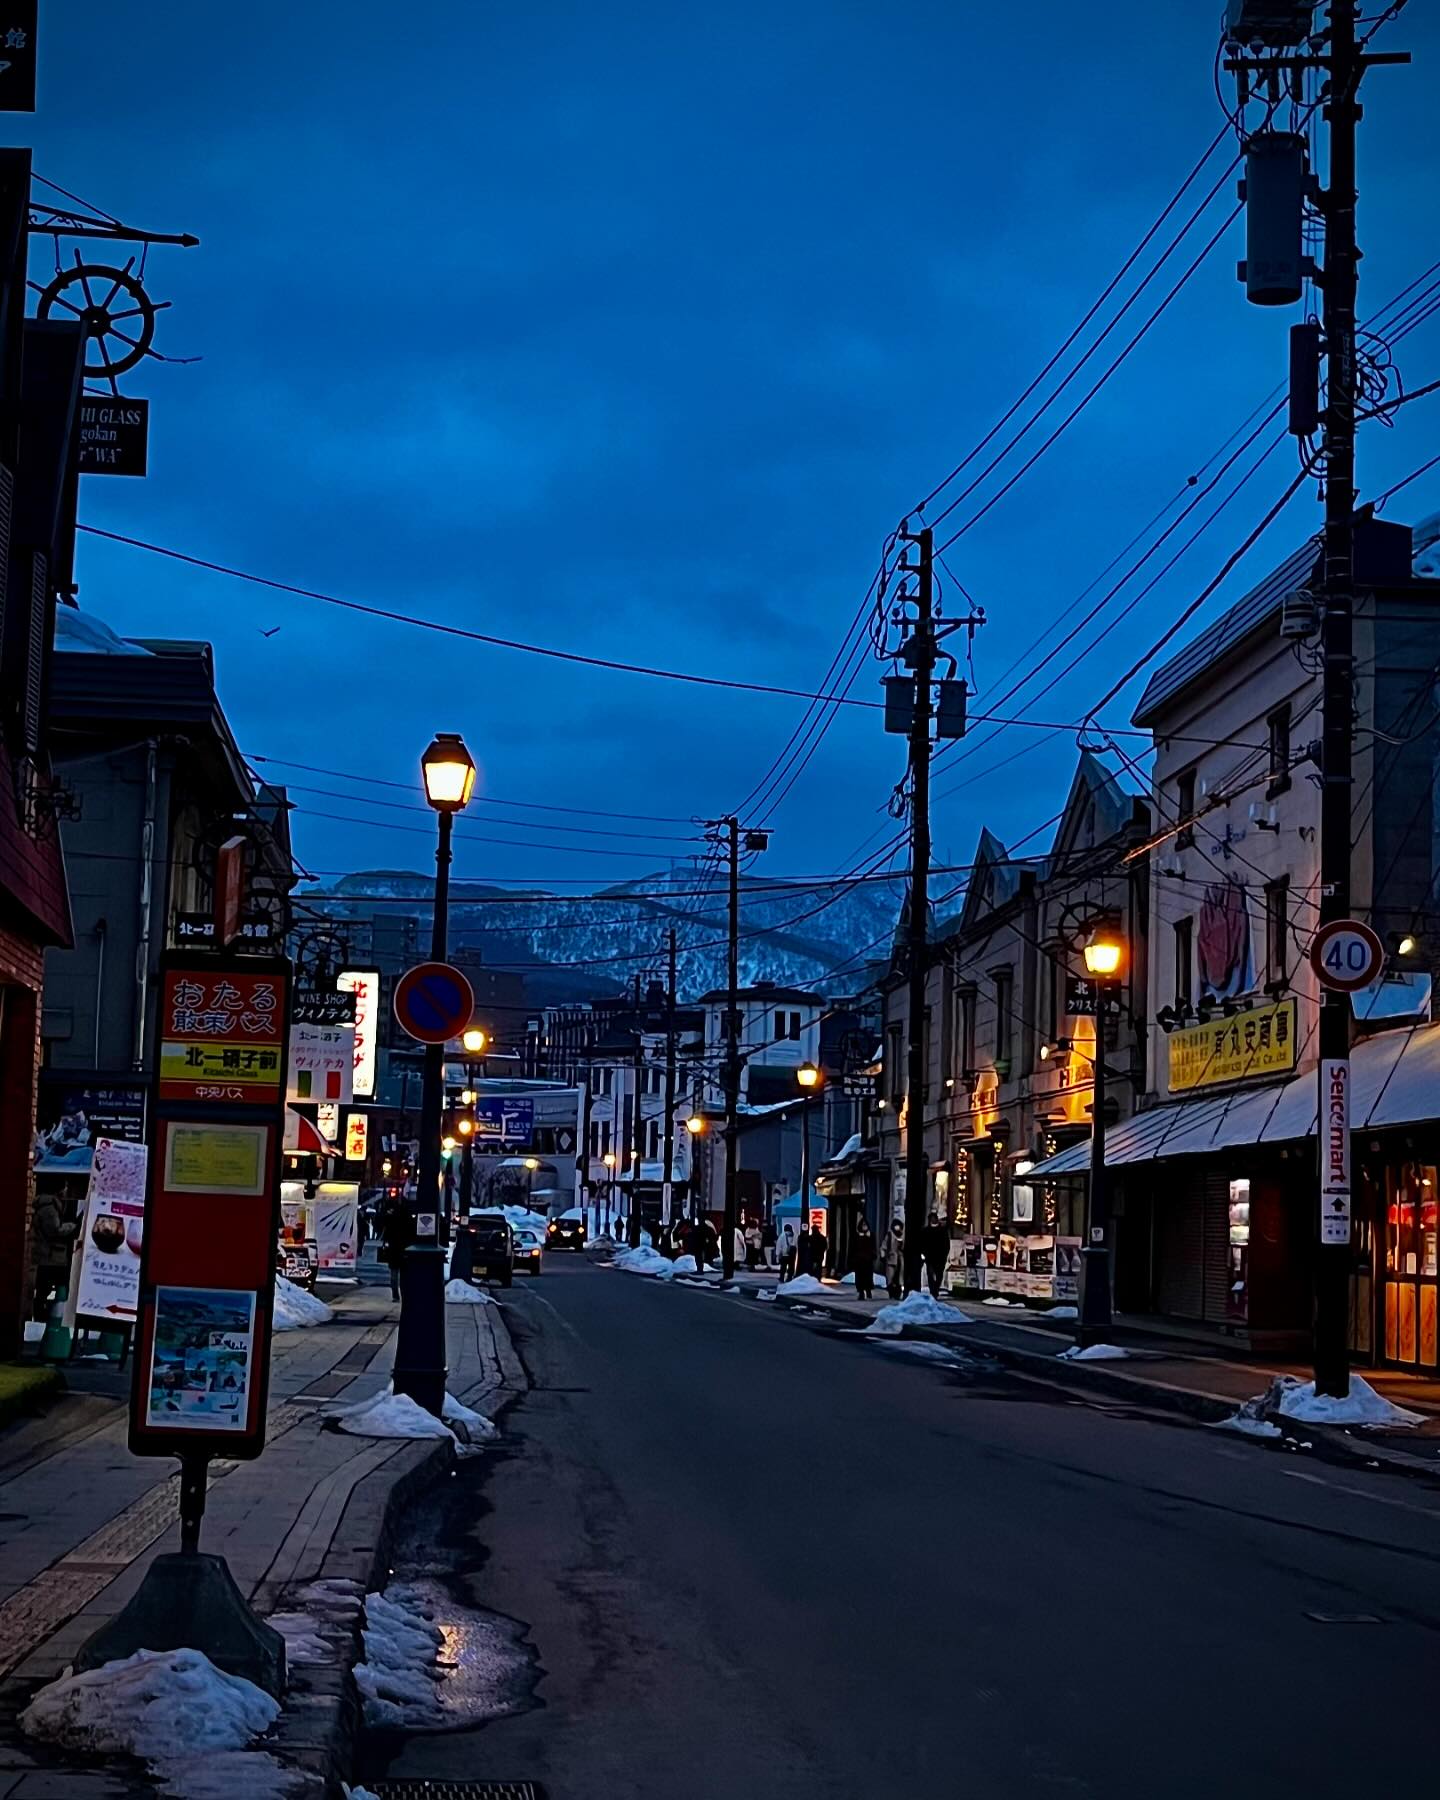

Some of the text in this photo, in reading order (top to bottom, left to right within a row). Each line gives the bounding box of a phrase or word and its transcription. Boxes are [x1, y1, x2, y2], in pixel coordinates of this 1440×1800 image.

[99, 407, 143, 425] GLASS
[1326, 941, 1366, 972] 40
[173, 978, 277, 1012] おたる
[298, 992, 348, 1005] WINE SHOP
[172, 1008, 277, 1035] 散策バス
[184, 1046, 279, 1070] 北一硝子前
[195, 1085, 244, 1099] 中央バス
[1329, 1066, 1348, 1183] Seicomart
